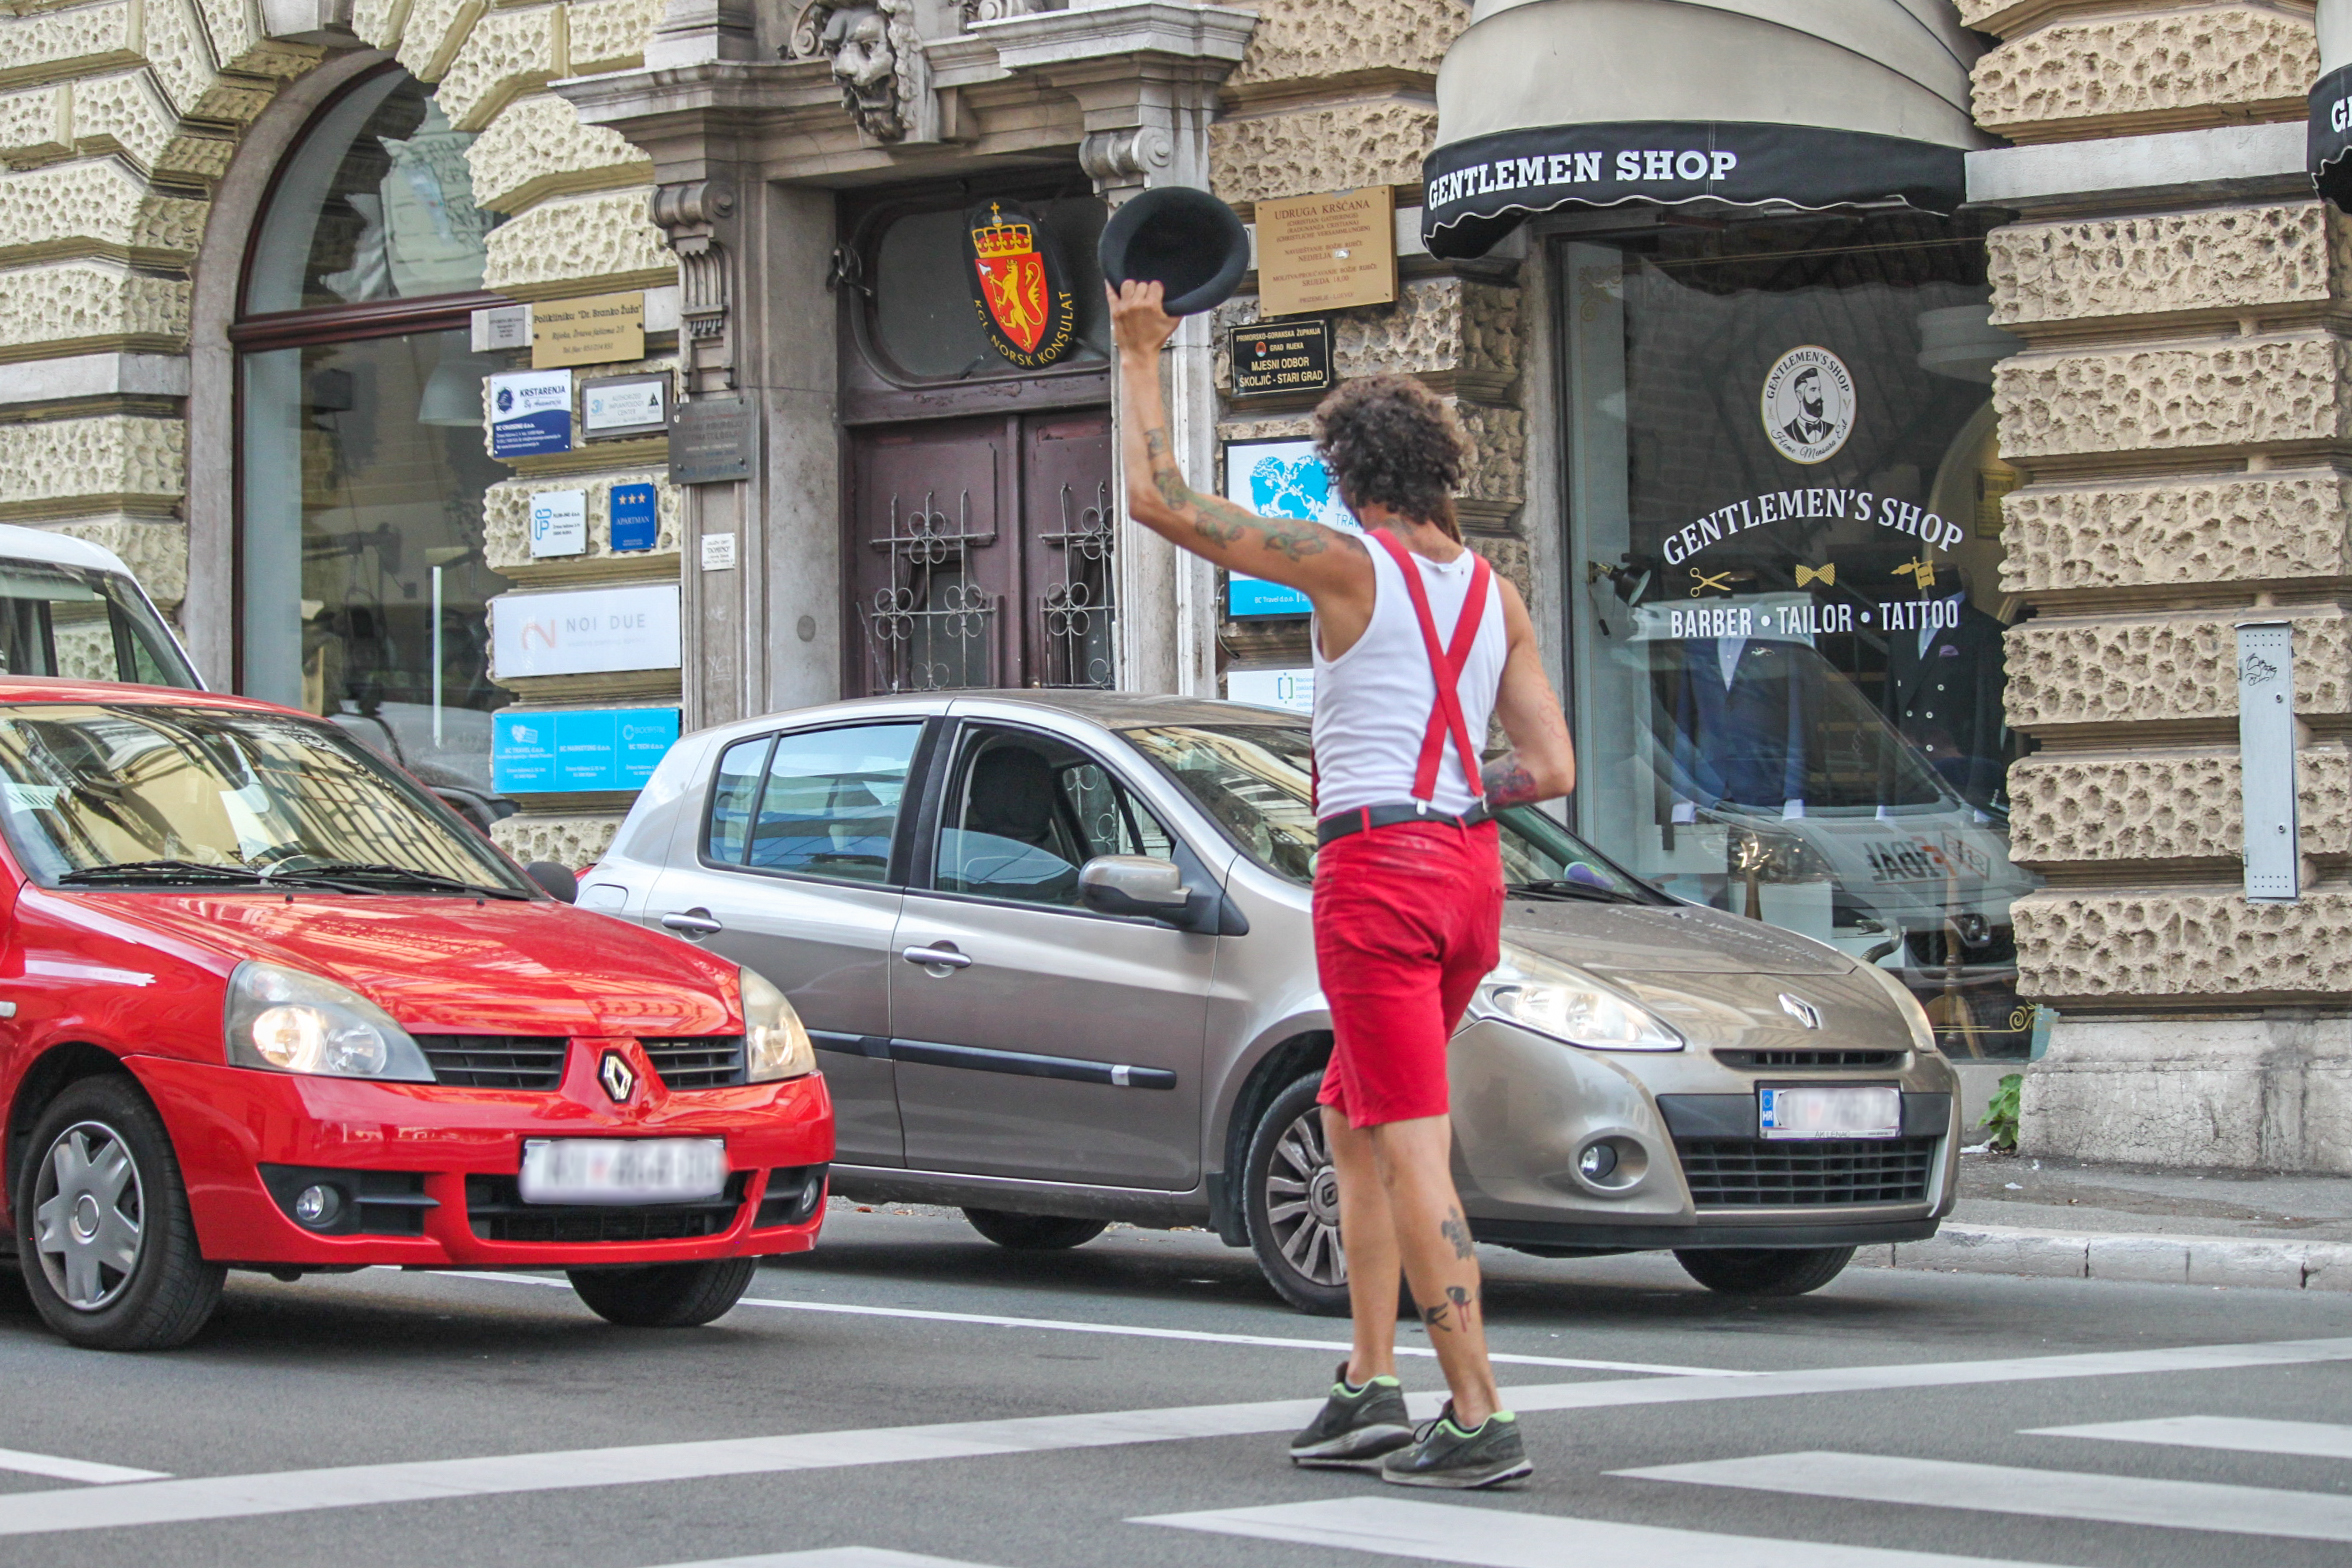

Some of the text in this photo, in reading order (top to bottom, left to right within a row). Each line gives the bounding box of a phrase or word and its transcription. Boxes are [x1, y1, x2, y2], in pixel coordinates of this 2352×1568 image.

[1428, 150, 1737, 211] GENTLEMEN SHOP
[1274, 207, 1317, 220] UDRUGA
[592, 308, 620, 319] Branko
[990, 335, 1035, 366] NORSK
[1037, 291, 1074, 364] KONSULAT
[1269, 342, 1304, 352] GRAD RIJEKA
[1251, 356, 1310, 371] MJESNI ODBOR
[1239, 372, 1271, 387] ŠKOLJIĆ
[1277, 372, 1299, 384] STARI
[1300, 370, 1323, 382] GRAD
[1766, 351, 1850, 399] GENTLEMEN'S SHOP
[519, 385, 566, 397] KRSTARENJA
[616, 515, 650, 526] APARTMAN
[1662, 488, 1873, 565] GENTLEMEN'S
[1878, 497, 1964, 552] SHOP
[566, 613, 646, 632] NOI DUE
[1670, 600, 1959, 638] BARBER TAILOR TATTOO
[1762, 1110, 1773, 1122] HR
